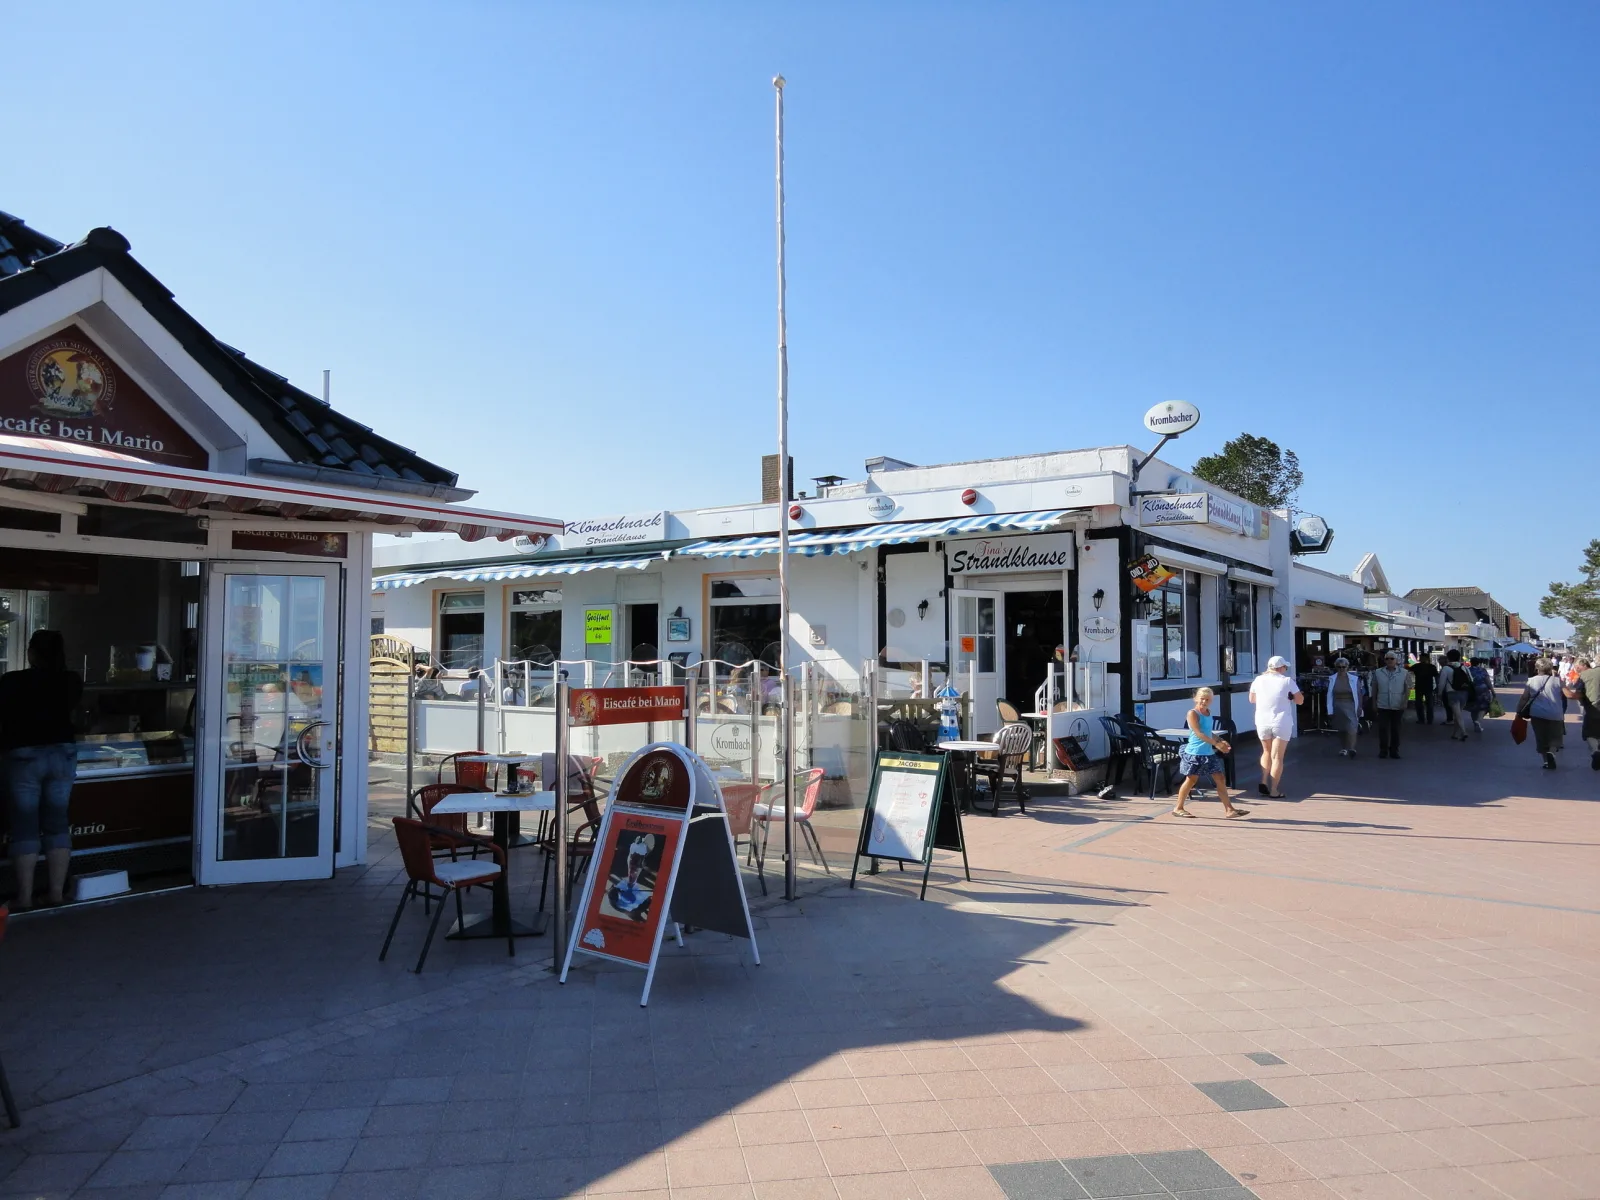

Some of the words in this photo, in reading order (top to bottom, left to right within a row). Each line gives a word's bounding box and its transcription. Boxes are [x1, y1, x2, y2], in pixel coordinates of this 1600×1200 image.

[1150, 412, 1193, 426] Krombacher
[0, 417, 51, 435] café
[58, 421, 93, 442] bei
[101, 427, 164, 452] Mario
[868, 503, 894, 512] Krombacher
[1142, 497, 1203, 512] Klönschnack
[564, 512, 662, 535] Klönschnack
[585, 533, 647, 546] Strandklause
[975, 540, 1008, 557] Tina's
[950, 545, 1067, 573] Strandklause
[1084, 626, 1115, 634] Krombacher
[603, 696, 636, 709] Eiscafé
[638, 697, 652, 708] bei
[655, 695, 681, 707] Mario
[897, 760, 922, 768] JACOBS
